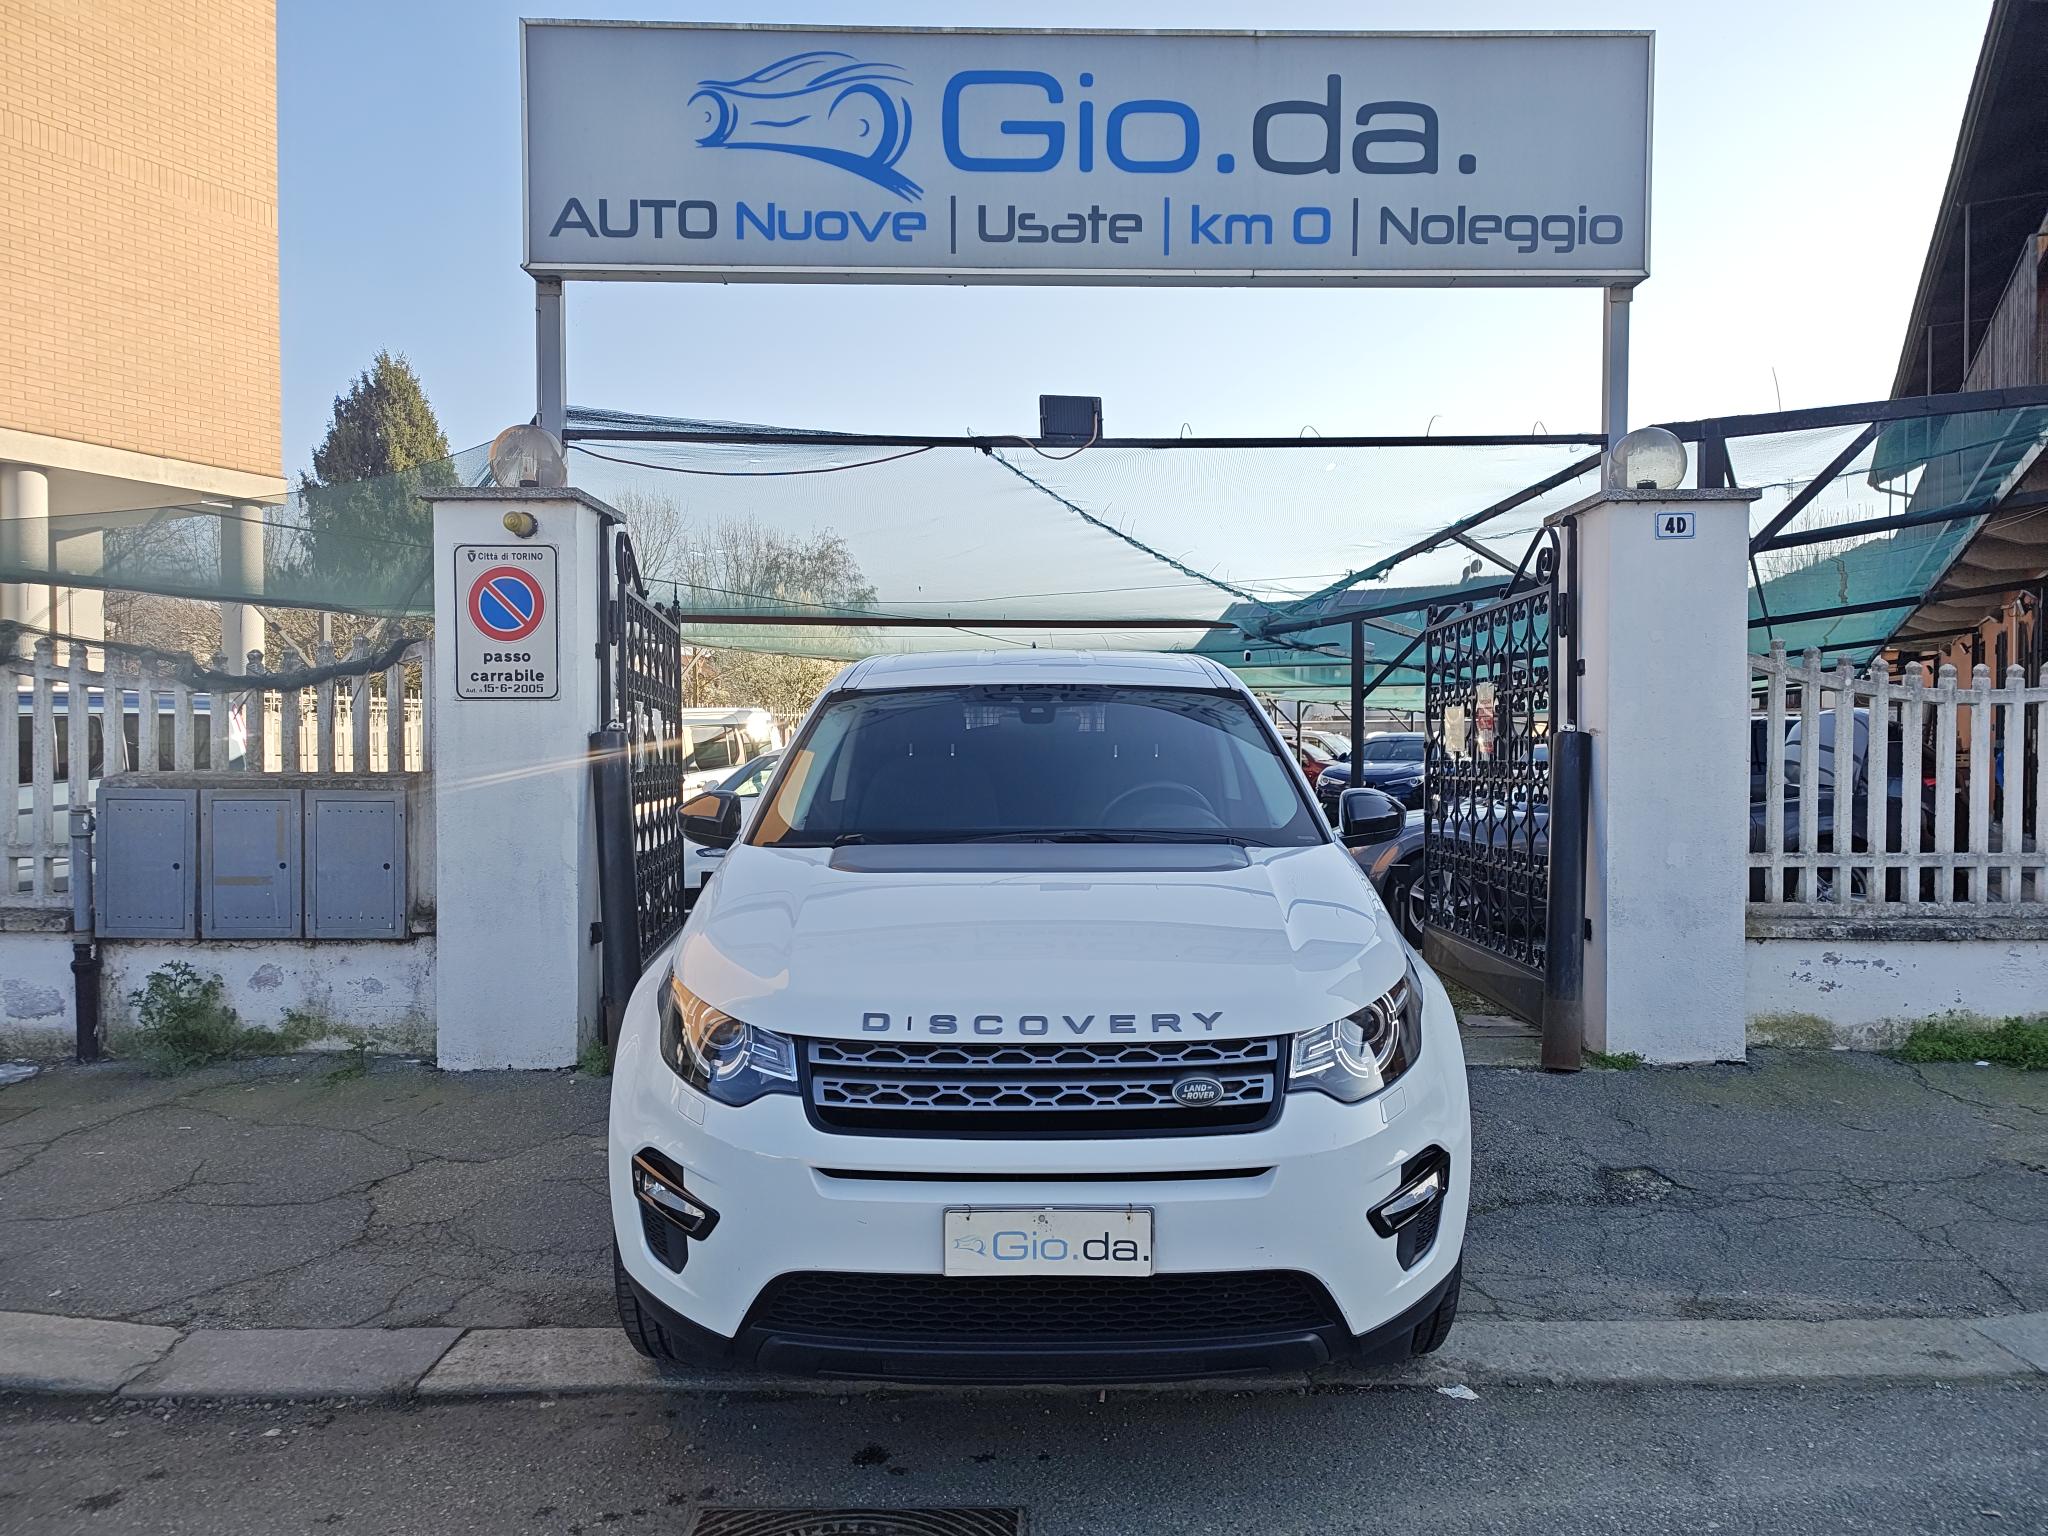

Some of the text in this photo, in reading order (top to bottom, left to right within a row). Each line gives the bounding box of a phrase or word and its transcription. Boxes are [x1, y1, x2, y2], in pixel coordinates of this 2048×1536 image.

[942, 69, 1477, 175] Gio.da.
[549, 197, 718, 240] AUTO
[736, 201, 927, 242] Nuove
[978, 204, 1143, 244] Usate
[1191, 204, 1273, 245] km
[1379, 205, 1623, 254] Noleggio
[1664, 516, 1687, 534] 4D
[501, 552, 509, 561] di
[511, 552, 544, 561] TORINO
[483, 652, 531, 665] passo
[470, 669, 545, 682] carrabile
[484, 683, 544, 693] 15-6-2005
[862, 1011, 1224, 1035] DISCOVERY
[992, 1231, 1150, 1262] Gio.da.
